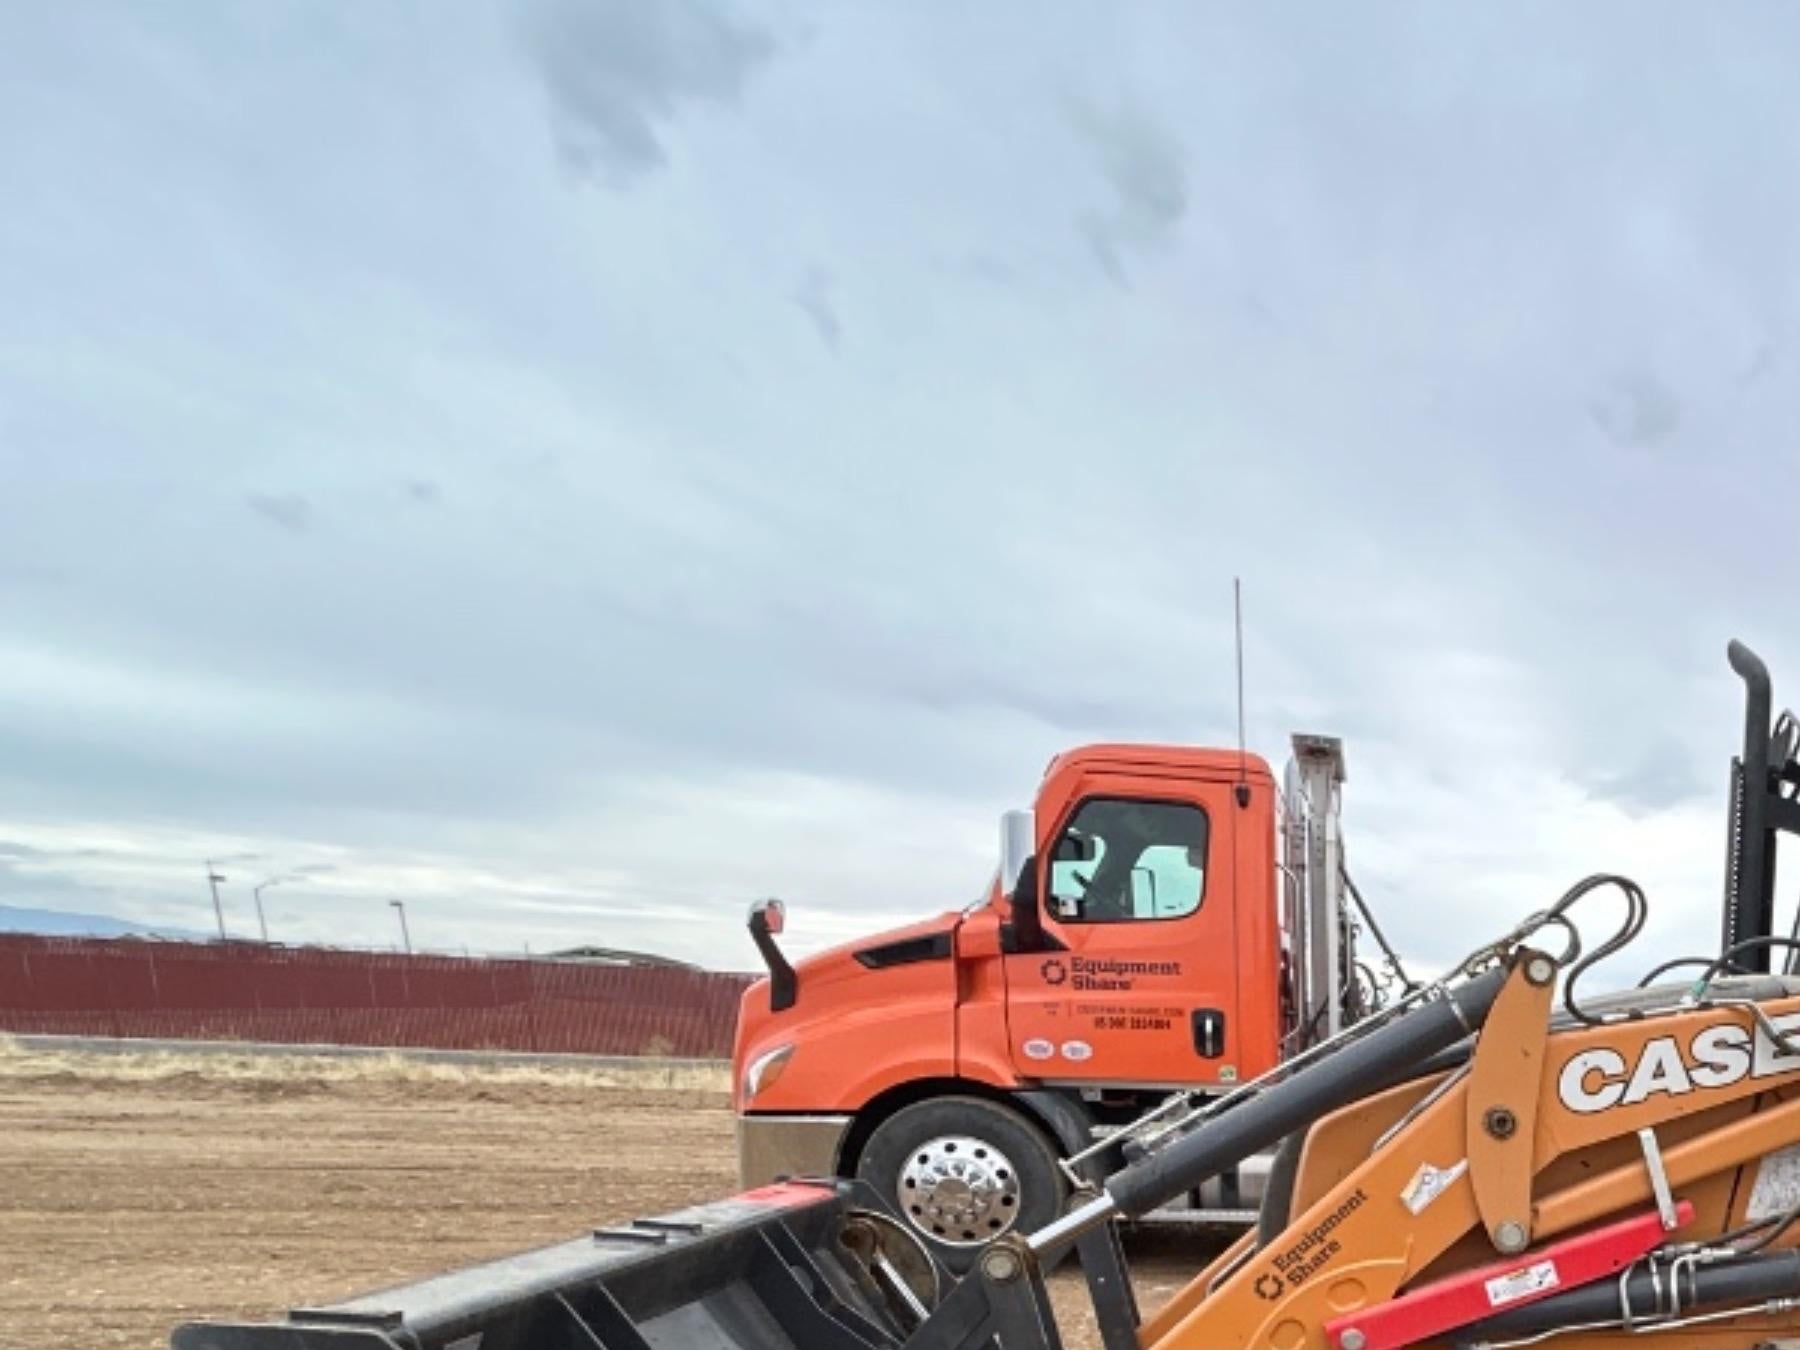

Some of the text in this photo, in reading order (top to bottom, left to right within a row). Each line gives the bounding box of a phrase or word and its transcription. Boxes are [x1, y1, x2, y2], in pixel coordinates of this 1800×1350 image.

[1070, 956, 1182, 976] Equipment
[1071, 975, 1133, 991] Share
[1272, 1188, 1368, 1273] Equipment
[1286, 1240, 1341, 1287] Share
